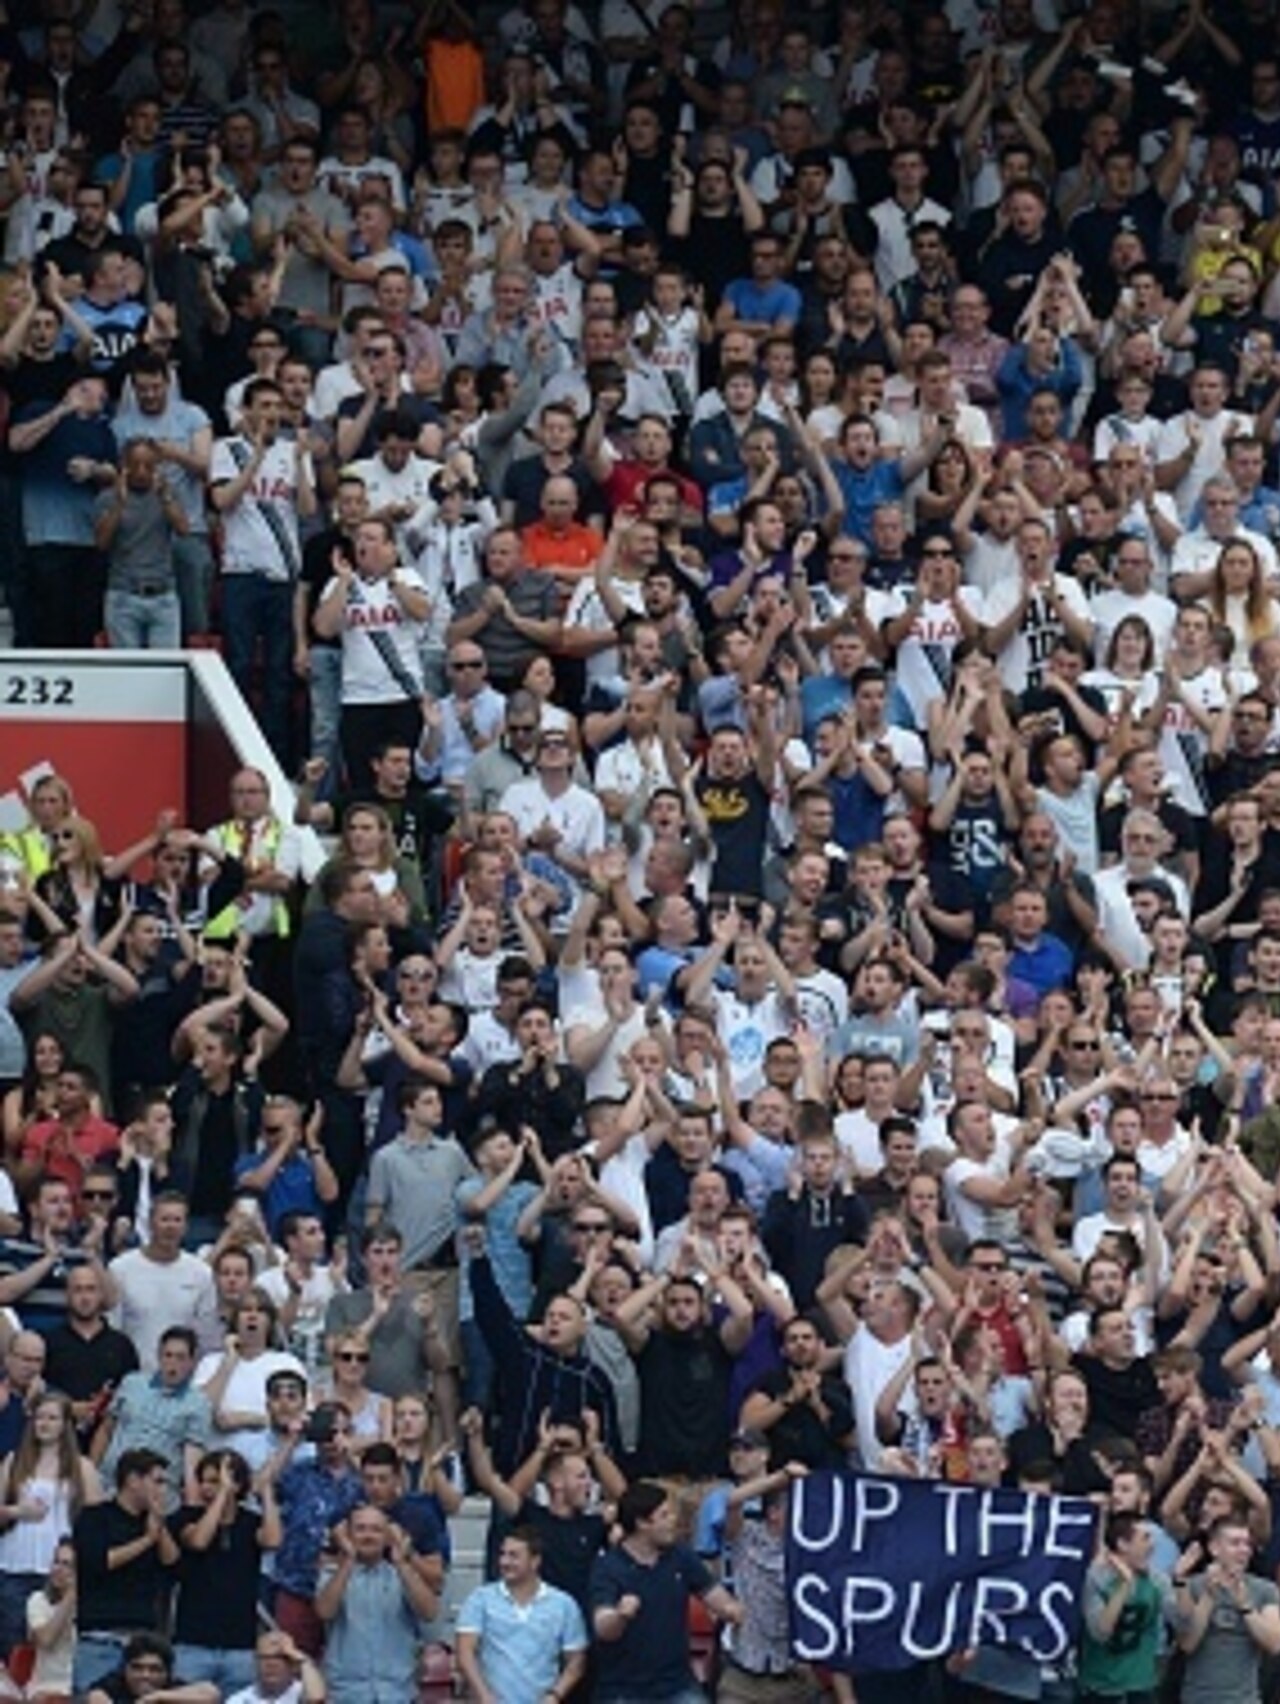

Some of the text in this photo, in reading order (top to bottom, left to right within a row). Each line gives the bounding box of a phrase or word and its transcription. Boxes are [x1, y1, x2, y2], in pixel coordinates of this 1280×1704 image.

[5, 676, 74, 704] 232
[792, 1476, 1092, 1559] UP THE
[794, 1573, 1074, 1661] SPURS
